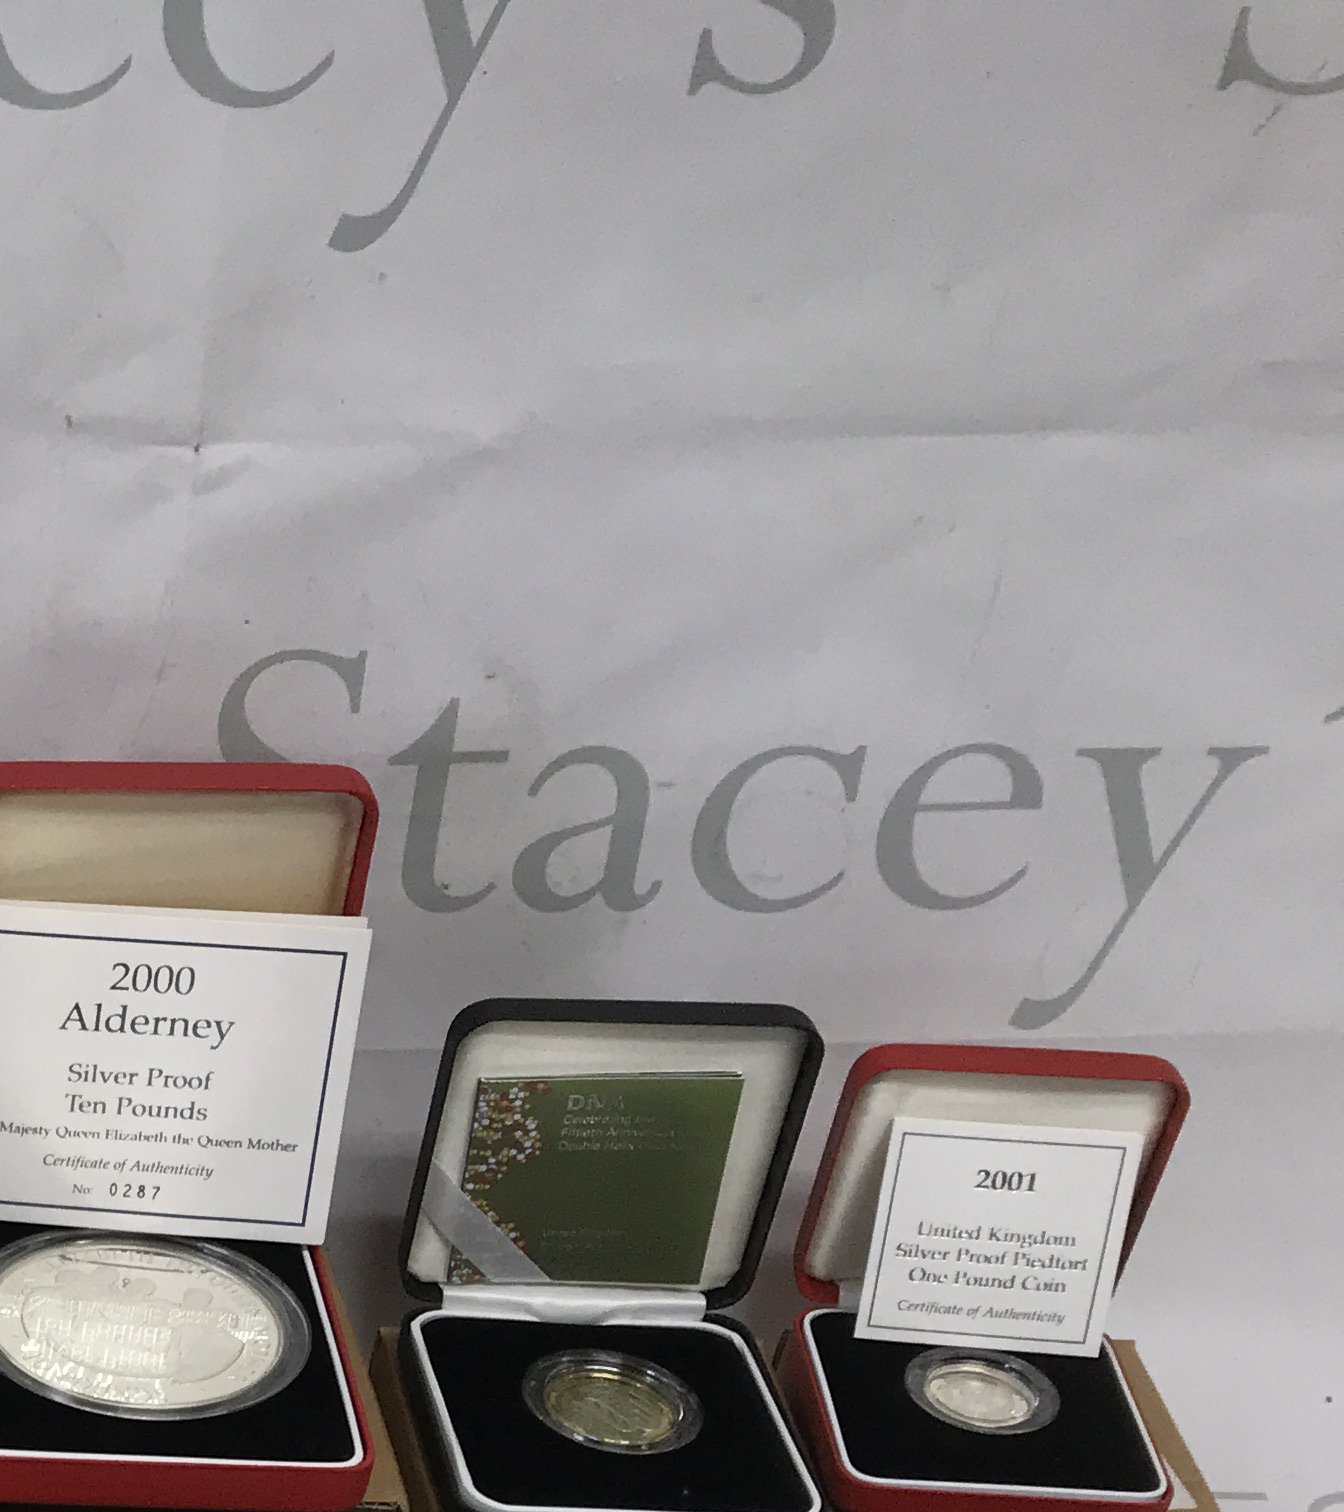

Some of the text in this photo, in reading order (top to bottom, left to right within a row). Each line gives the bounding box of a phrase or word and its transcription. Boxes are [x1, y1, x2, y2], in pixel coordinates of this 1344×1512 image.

[108, 962, 196, 996] 2000
[58, 1002, 235, 1049] Alderney
[67, 1063, 215, 1091] Silver Proof
[64, 1093, 208, 1122] Ten Pounds
[0, 1120, 52, 1141] Majesty
[55, 1125, 101, 1144] Queen
[104, 1127, 169, 1145] Elizabeth
[171, 1131, 194, 1147] the
[197, 1133, 242, 1150] Queen
[247, 1137, 299, 1154] Mother
[42, 1153, 214, 1180] Certificate of Authenticity
[973, 1168, 1038, 1193] 2001
[108, 1182, 162, 1201] 0287
[916, 1220, 1077, 1250] United Kingdom
[894, 1242, 950, 1262] Silver
[955, 1246, 1007, 1266] Proof
[907, 1267, 1068, 1295] One Pound Coin
[896, 1298, 1067, 1326] Certificate of Authenticity
